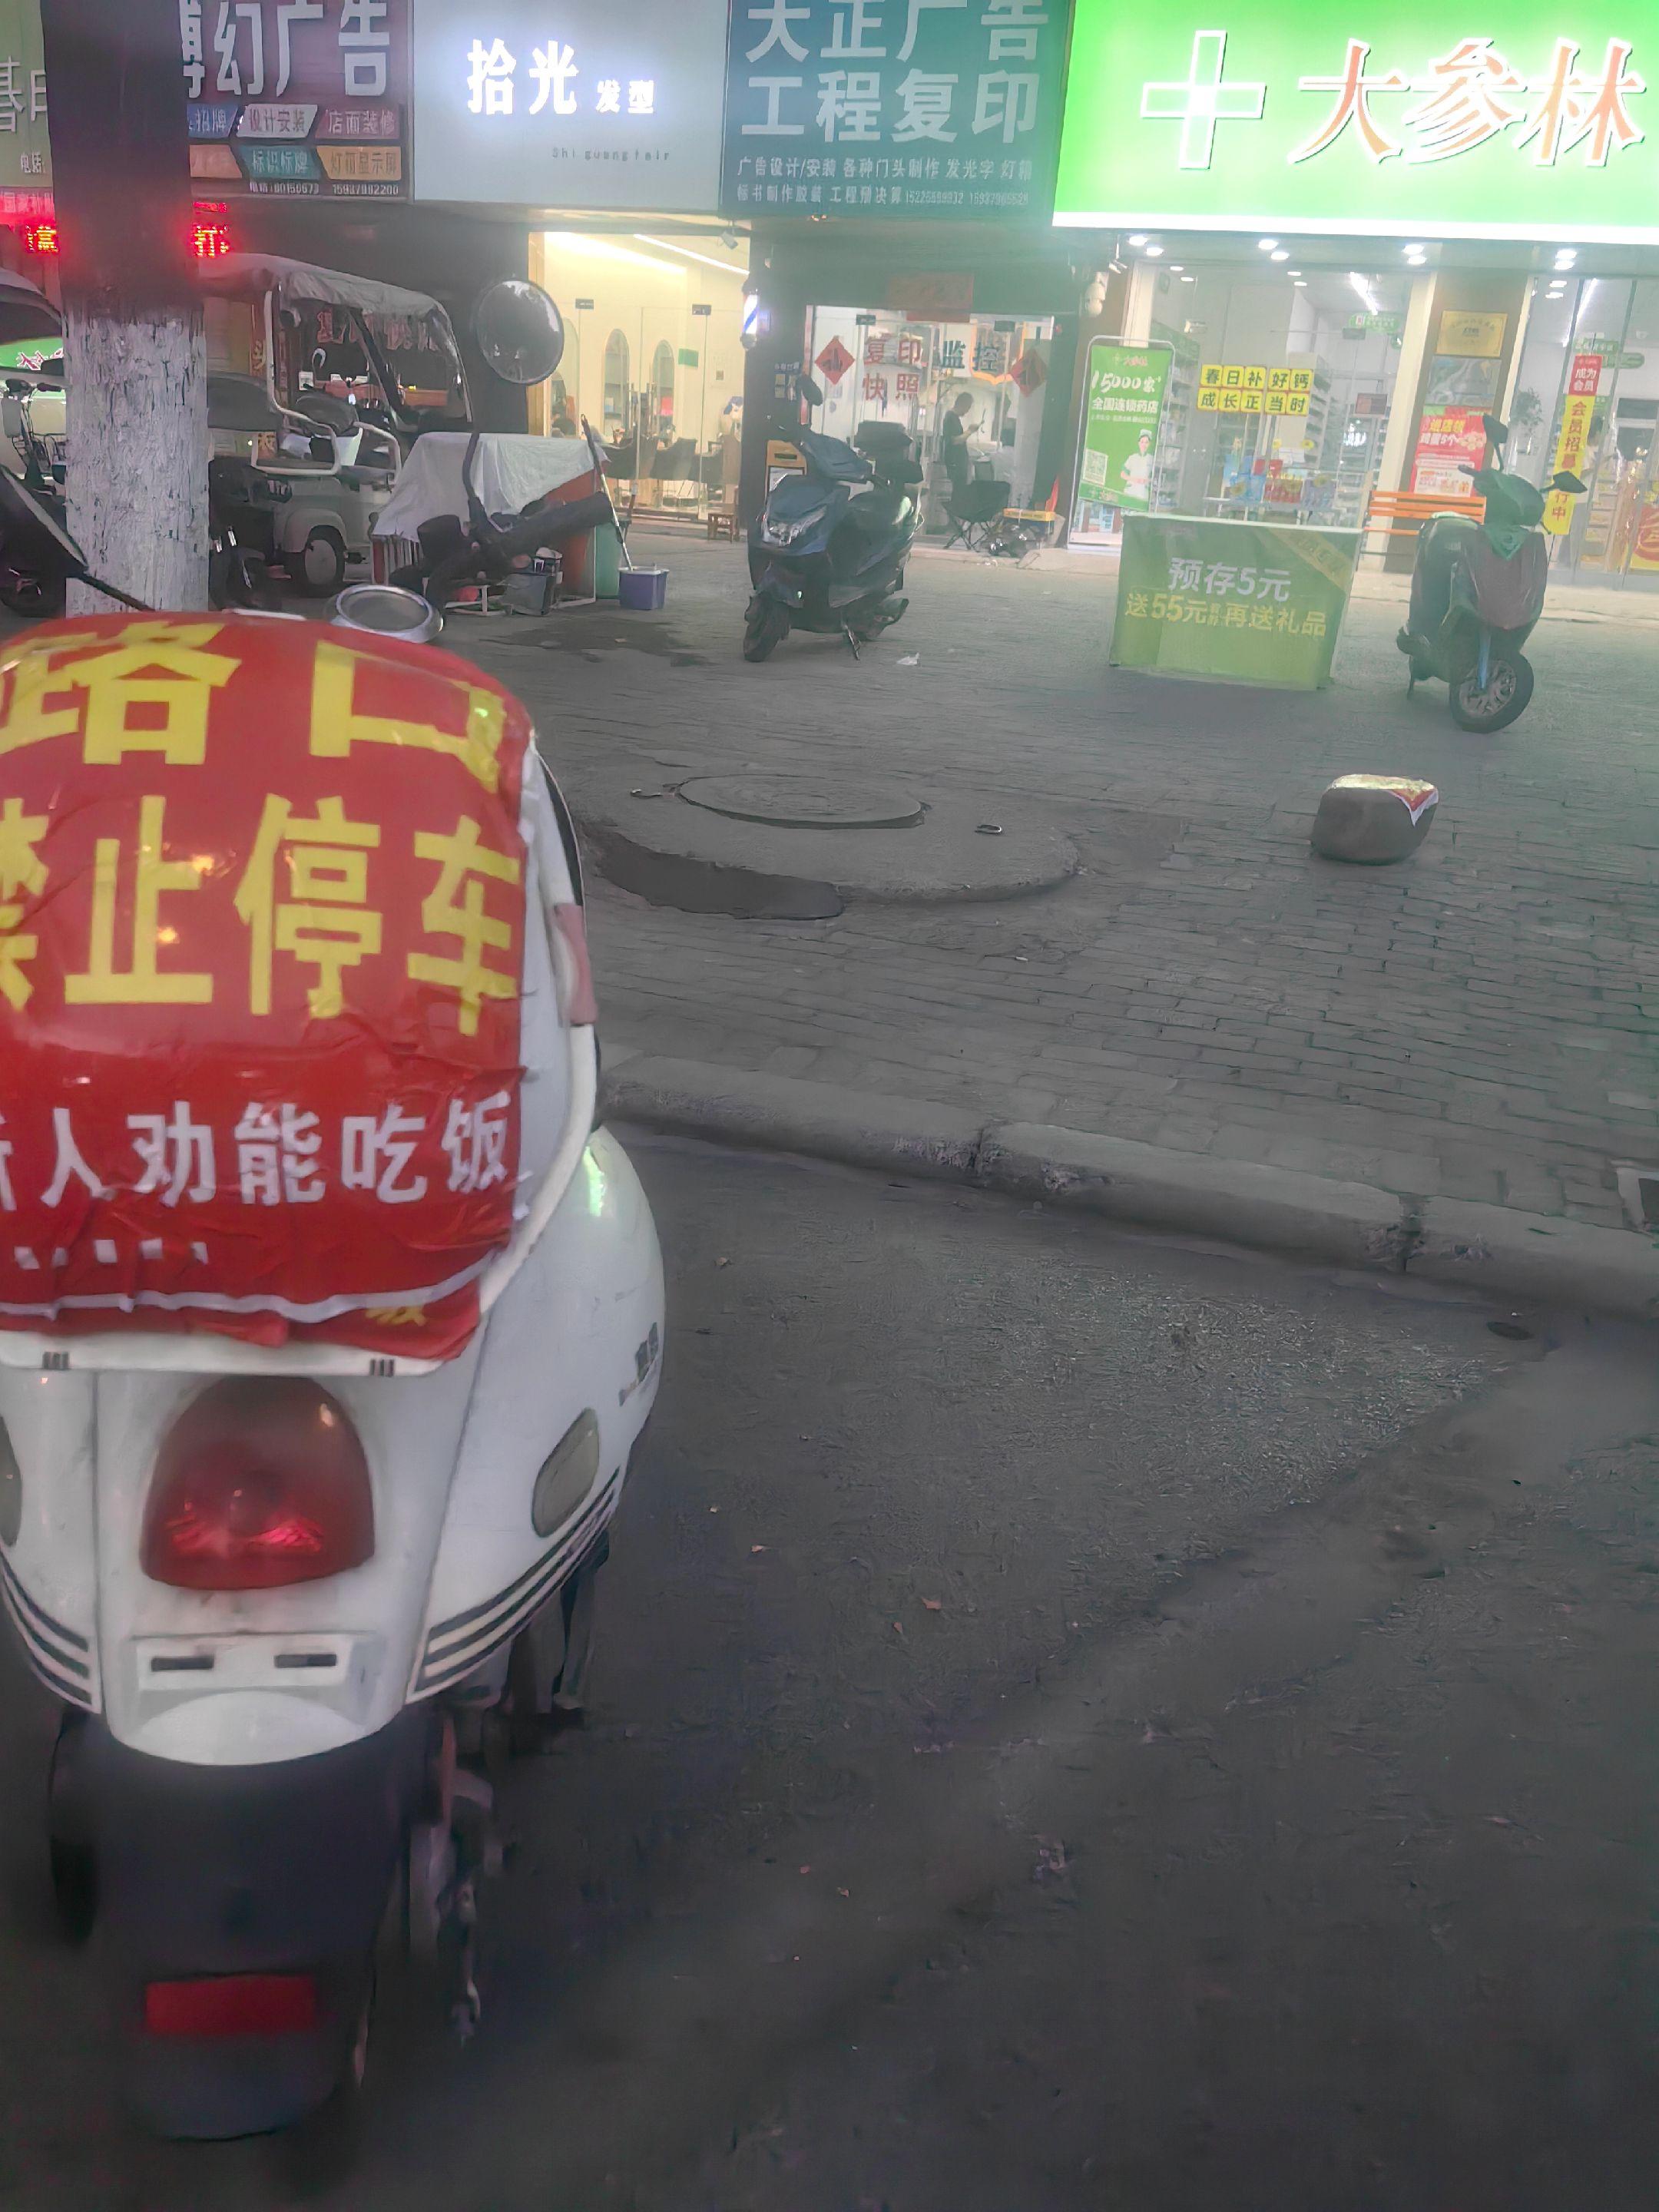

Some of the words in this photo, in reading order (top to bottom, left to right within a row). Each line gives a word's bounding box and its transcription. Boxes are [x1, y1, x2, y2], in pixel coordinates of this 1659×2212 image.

[467, 38, 578, 114] 拾光
[595, 79, 654, 114] 发型
[741, 68, 1040, 144] 工程复印
[1287, 38, 1646, 167] 大参林
[250, 108, 306, 134] 设计安装
[327, 109, 395, 134] 店面装修
[863, 336, 922, 366] 复印
[942, 339, 1000, 371] 监控
[862, 372, 920, 402] 快照
[1205, 367, 1309, 389] 春日补好钙
[1200, 391, 1306, 413] 成长正当时
[1168, 557, 1292, 602] 预存5元
[0, 1090, 512, 1212] 人劝能吃饭
